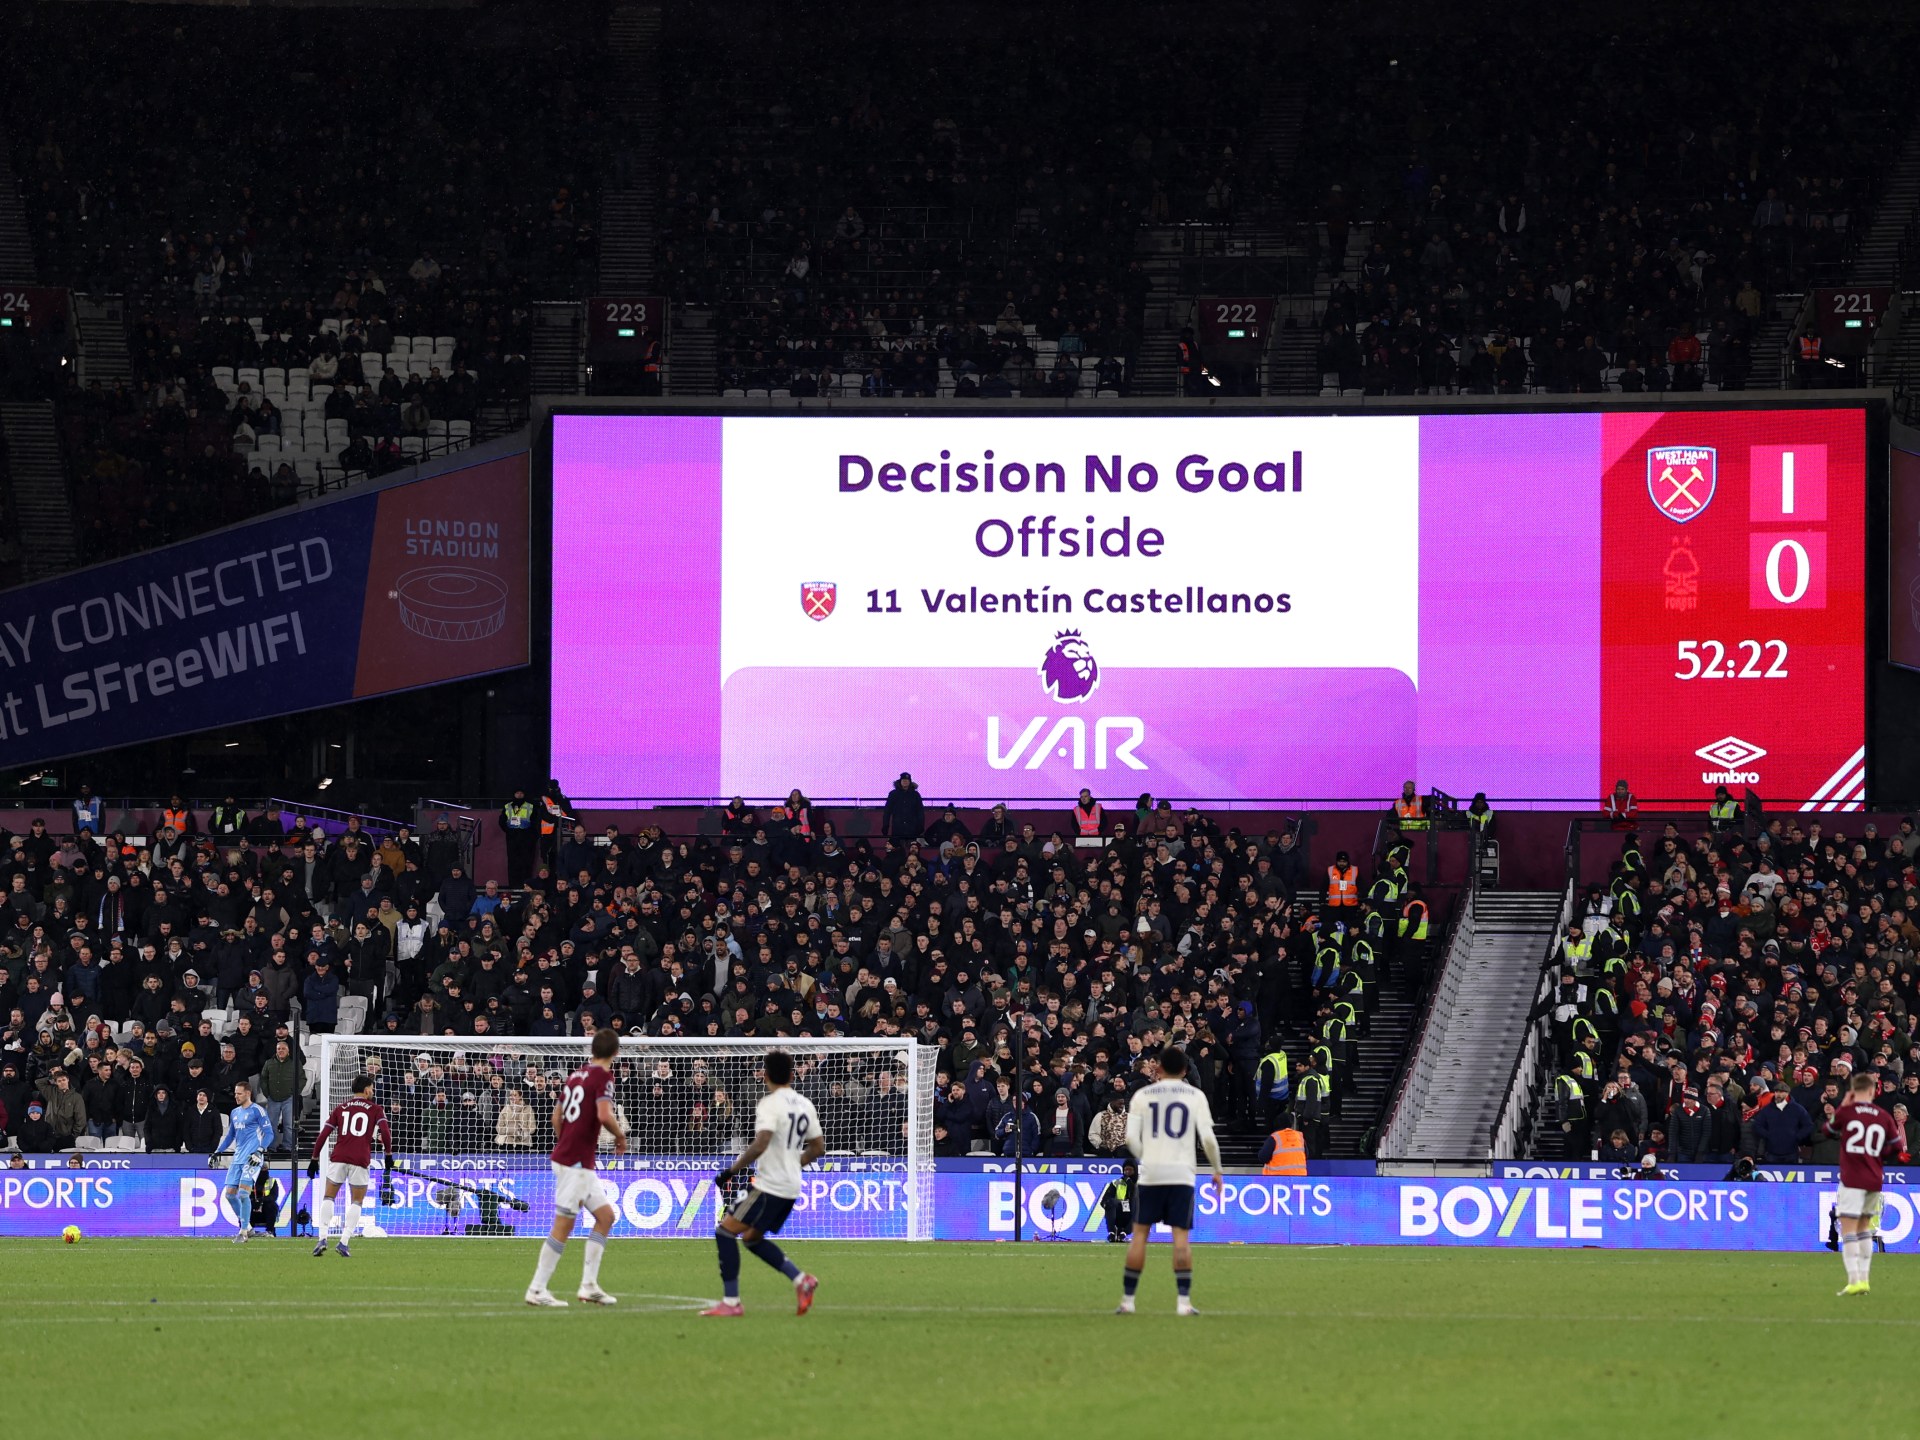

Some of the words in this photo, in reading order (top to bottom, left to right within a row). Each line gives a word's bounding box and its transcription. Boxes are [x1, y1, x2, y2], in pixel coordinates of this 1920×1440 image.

[0, 292, 30, 312] 24
[606, 303, 646, 322] 223
[1217, 304, 1257, 323] 222
[1833, 293, 1874, 313] 221
[839, 450, 1066, 493] Decision
[1085, 455, 1159, 493] No
[1175, 451, 1302, 493] Goal
[1782, 452, 1794, 514] 1
[406, 518, 498, 539] LONDON
[975, 515, 1165, 558] Offside
[406, 538, 498, 558] STADIUM
[1765, 539, 1810, 603] 0
[52, 537, 333, 653] CONNECTED
[867, 590, 901, 613] 11
[921, 585, 1072, 613] Valentín
[1083, 586, 1292, 613] Castellanos
[35, 611, 306, 729] LSFreeWIFI
[1674, 640, 1788, 680] 52:22
[986, 716, 1149, 770] VAR
[1702, 770, 1760, 784] umbro
[341, 1111, 369, 1137] 10
[787, 1113, 810, 1149] 19
[1149, 1102, 1189, 1139] 10
[1846, 1120, 1886, 1157] 20
[0, 1177, 114, 1209] PORTS
[1198, 1183, 1332, 1216] SPORTS
[1399, 1185, 1603, 1239] BOYLE
[1613, 1187, 1749, 1222] SPORTS
